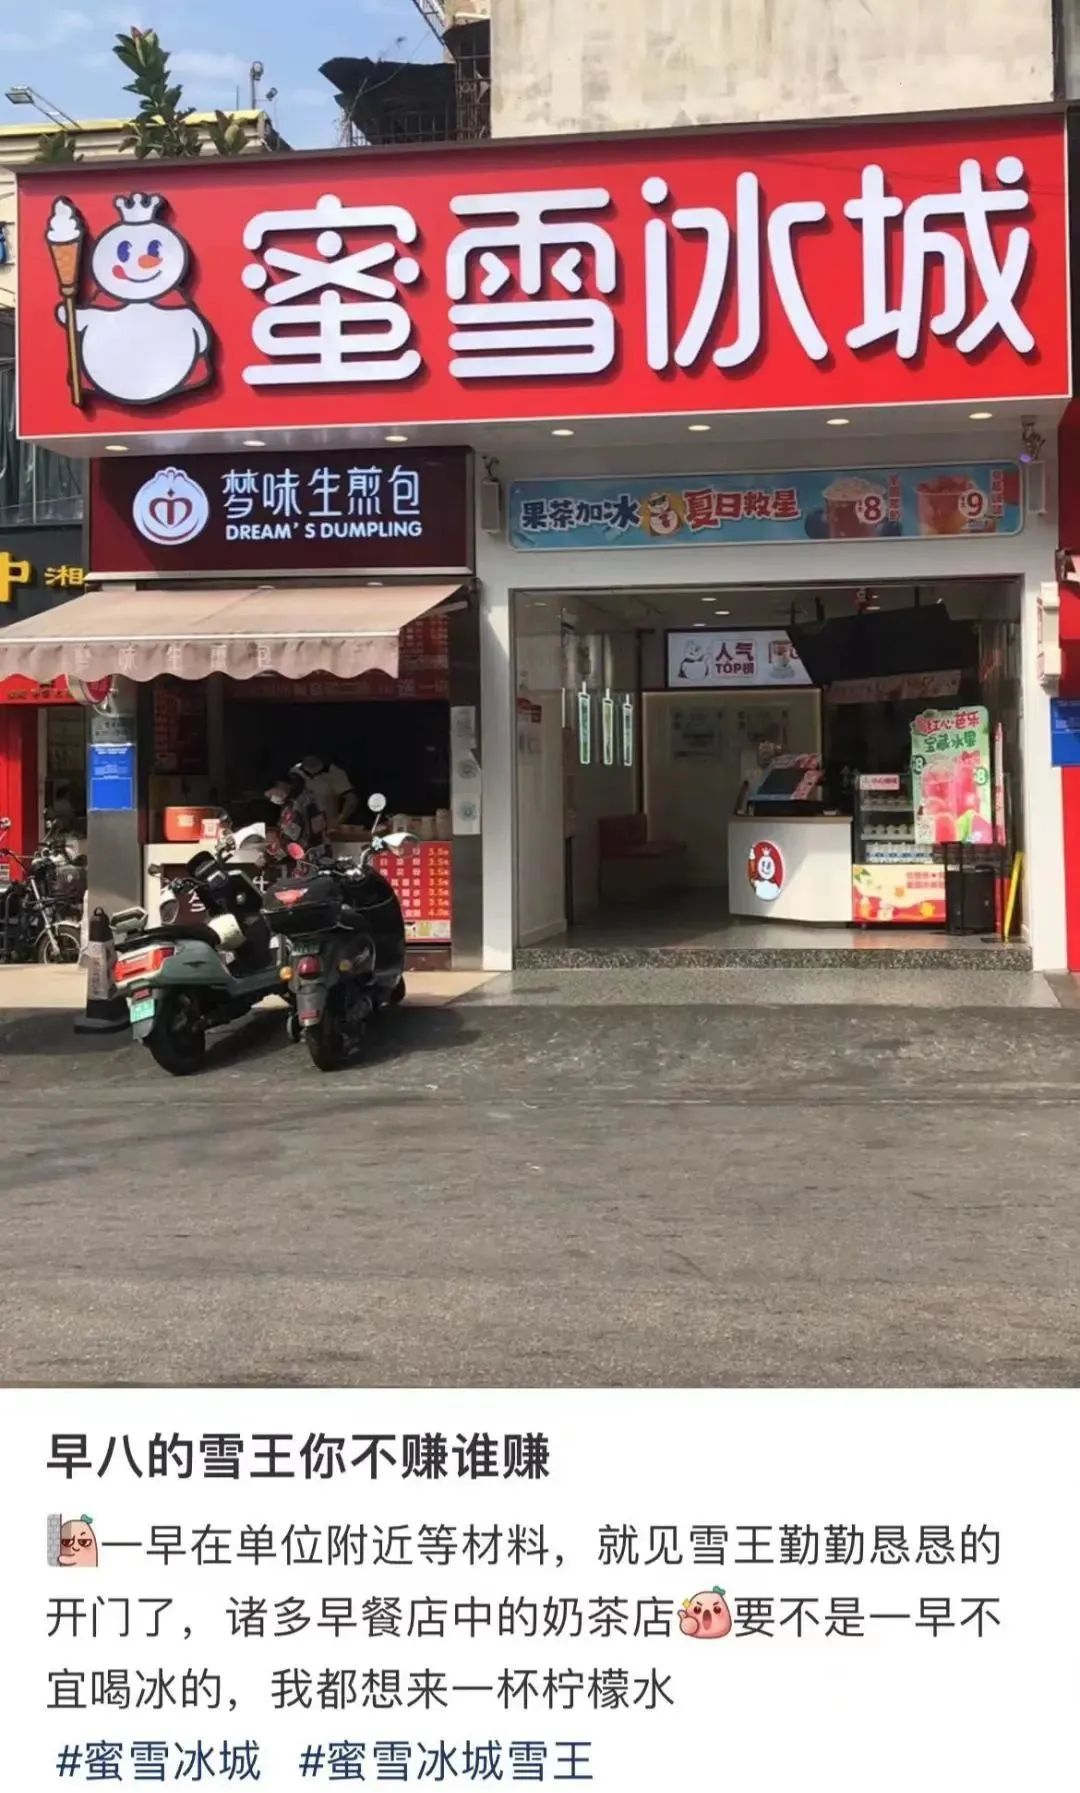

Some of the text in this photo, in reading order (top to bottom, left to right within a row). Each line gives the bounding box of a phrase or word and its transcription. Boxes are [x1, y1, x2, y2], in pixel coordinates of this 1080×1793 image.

[242, 156, 1034, 385] 蜜雪冰城
[221, 465, 421, 518] 梦味生煎包
[521, 490, 800, 531] 果茶加冰 夏日救星
[319, 521, 423, 538] DUMPLING
[44, 565, 83, 586] 湘
[715, 642, 754, 662] 人气
